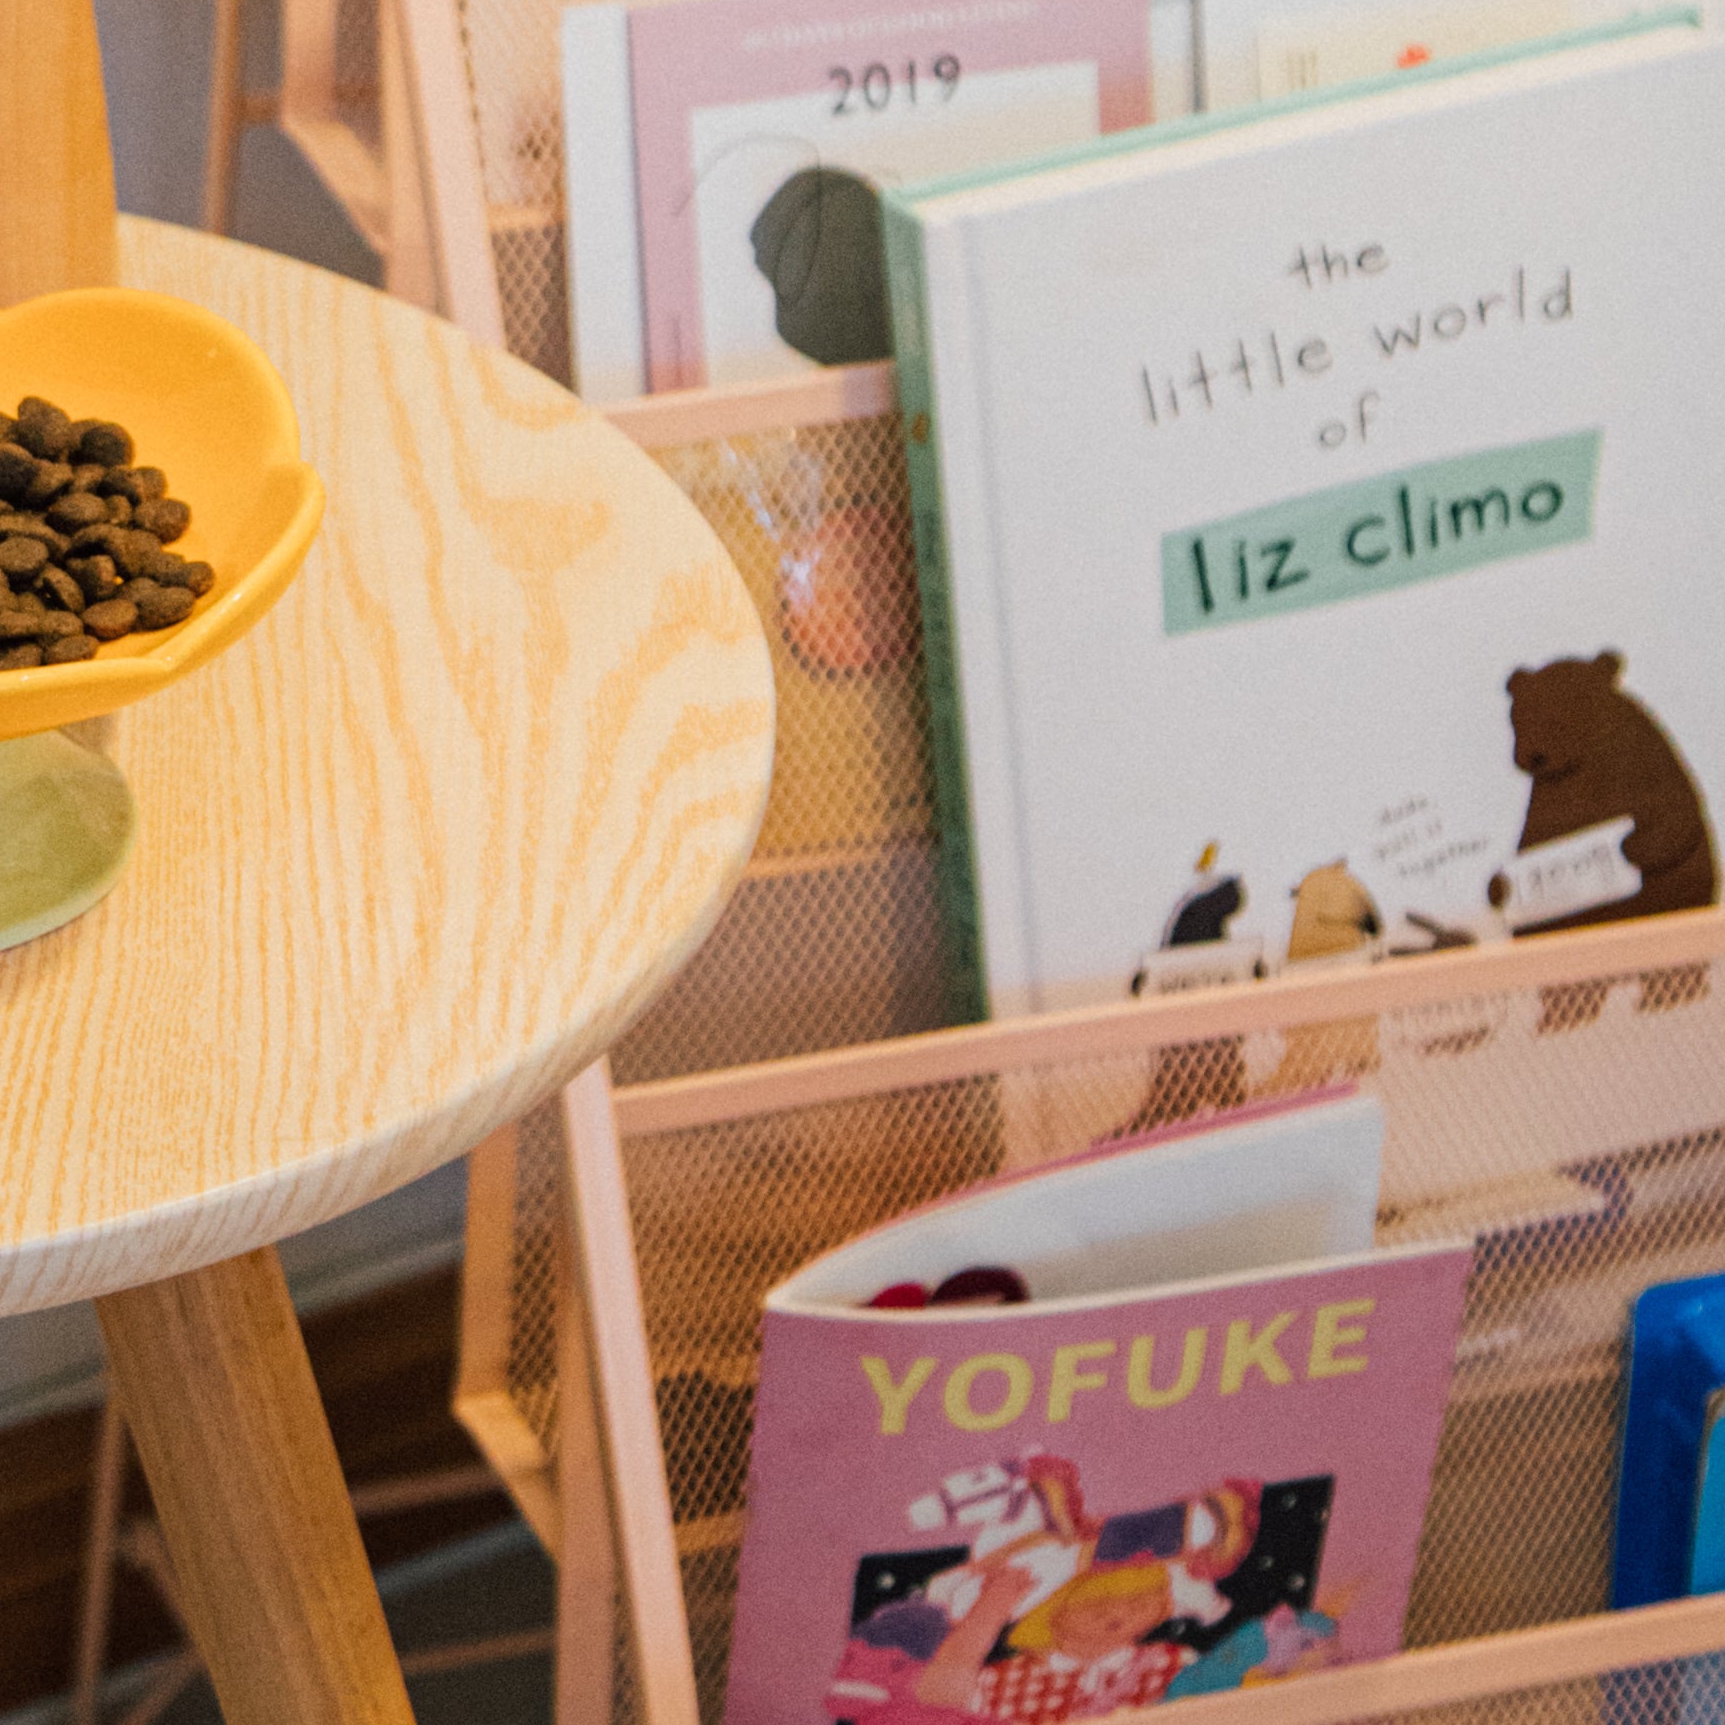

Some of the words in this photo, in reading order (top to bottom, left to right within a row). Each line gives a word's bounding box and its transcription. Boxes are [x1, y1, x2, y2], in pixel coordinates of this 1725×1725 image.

[829, 53, 961, 117] 2019
[1288, 242, 1388, 290] the
[1141, 329, 1333, 427] little
[1374, 264, 1573, 358] world
[1318, 388, 1380, 450] of
[1190, 536, 1311, 616] liz
[1344, 481, 1565, 569] climo
[859, 1298, 1377, 1437] YOFUKE
